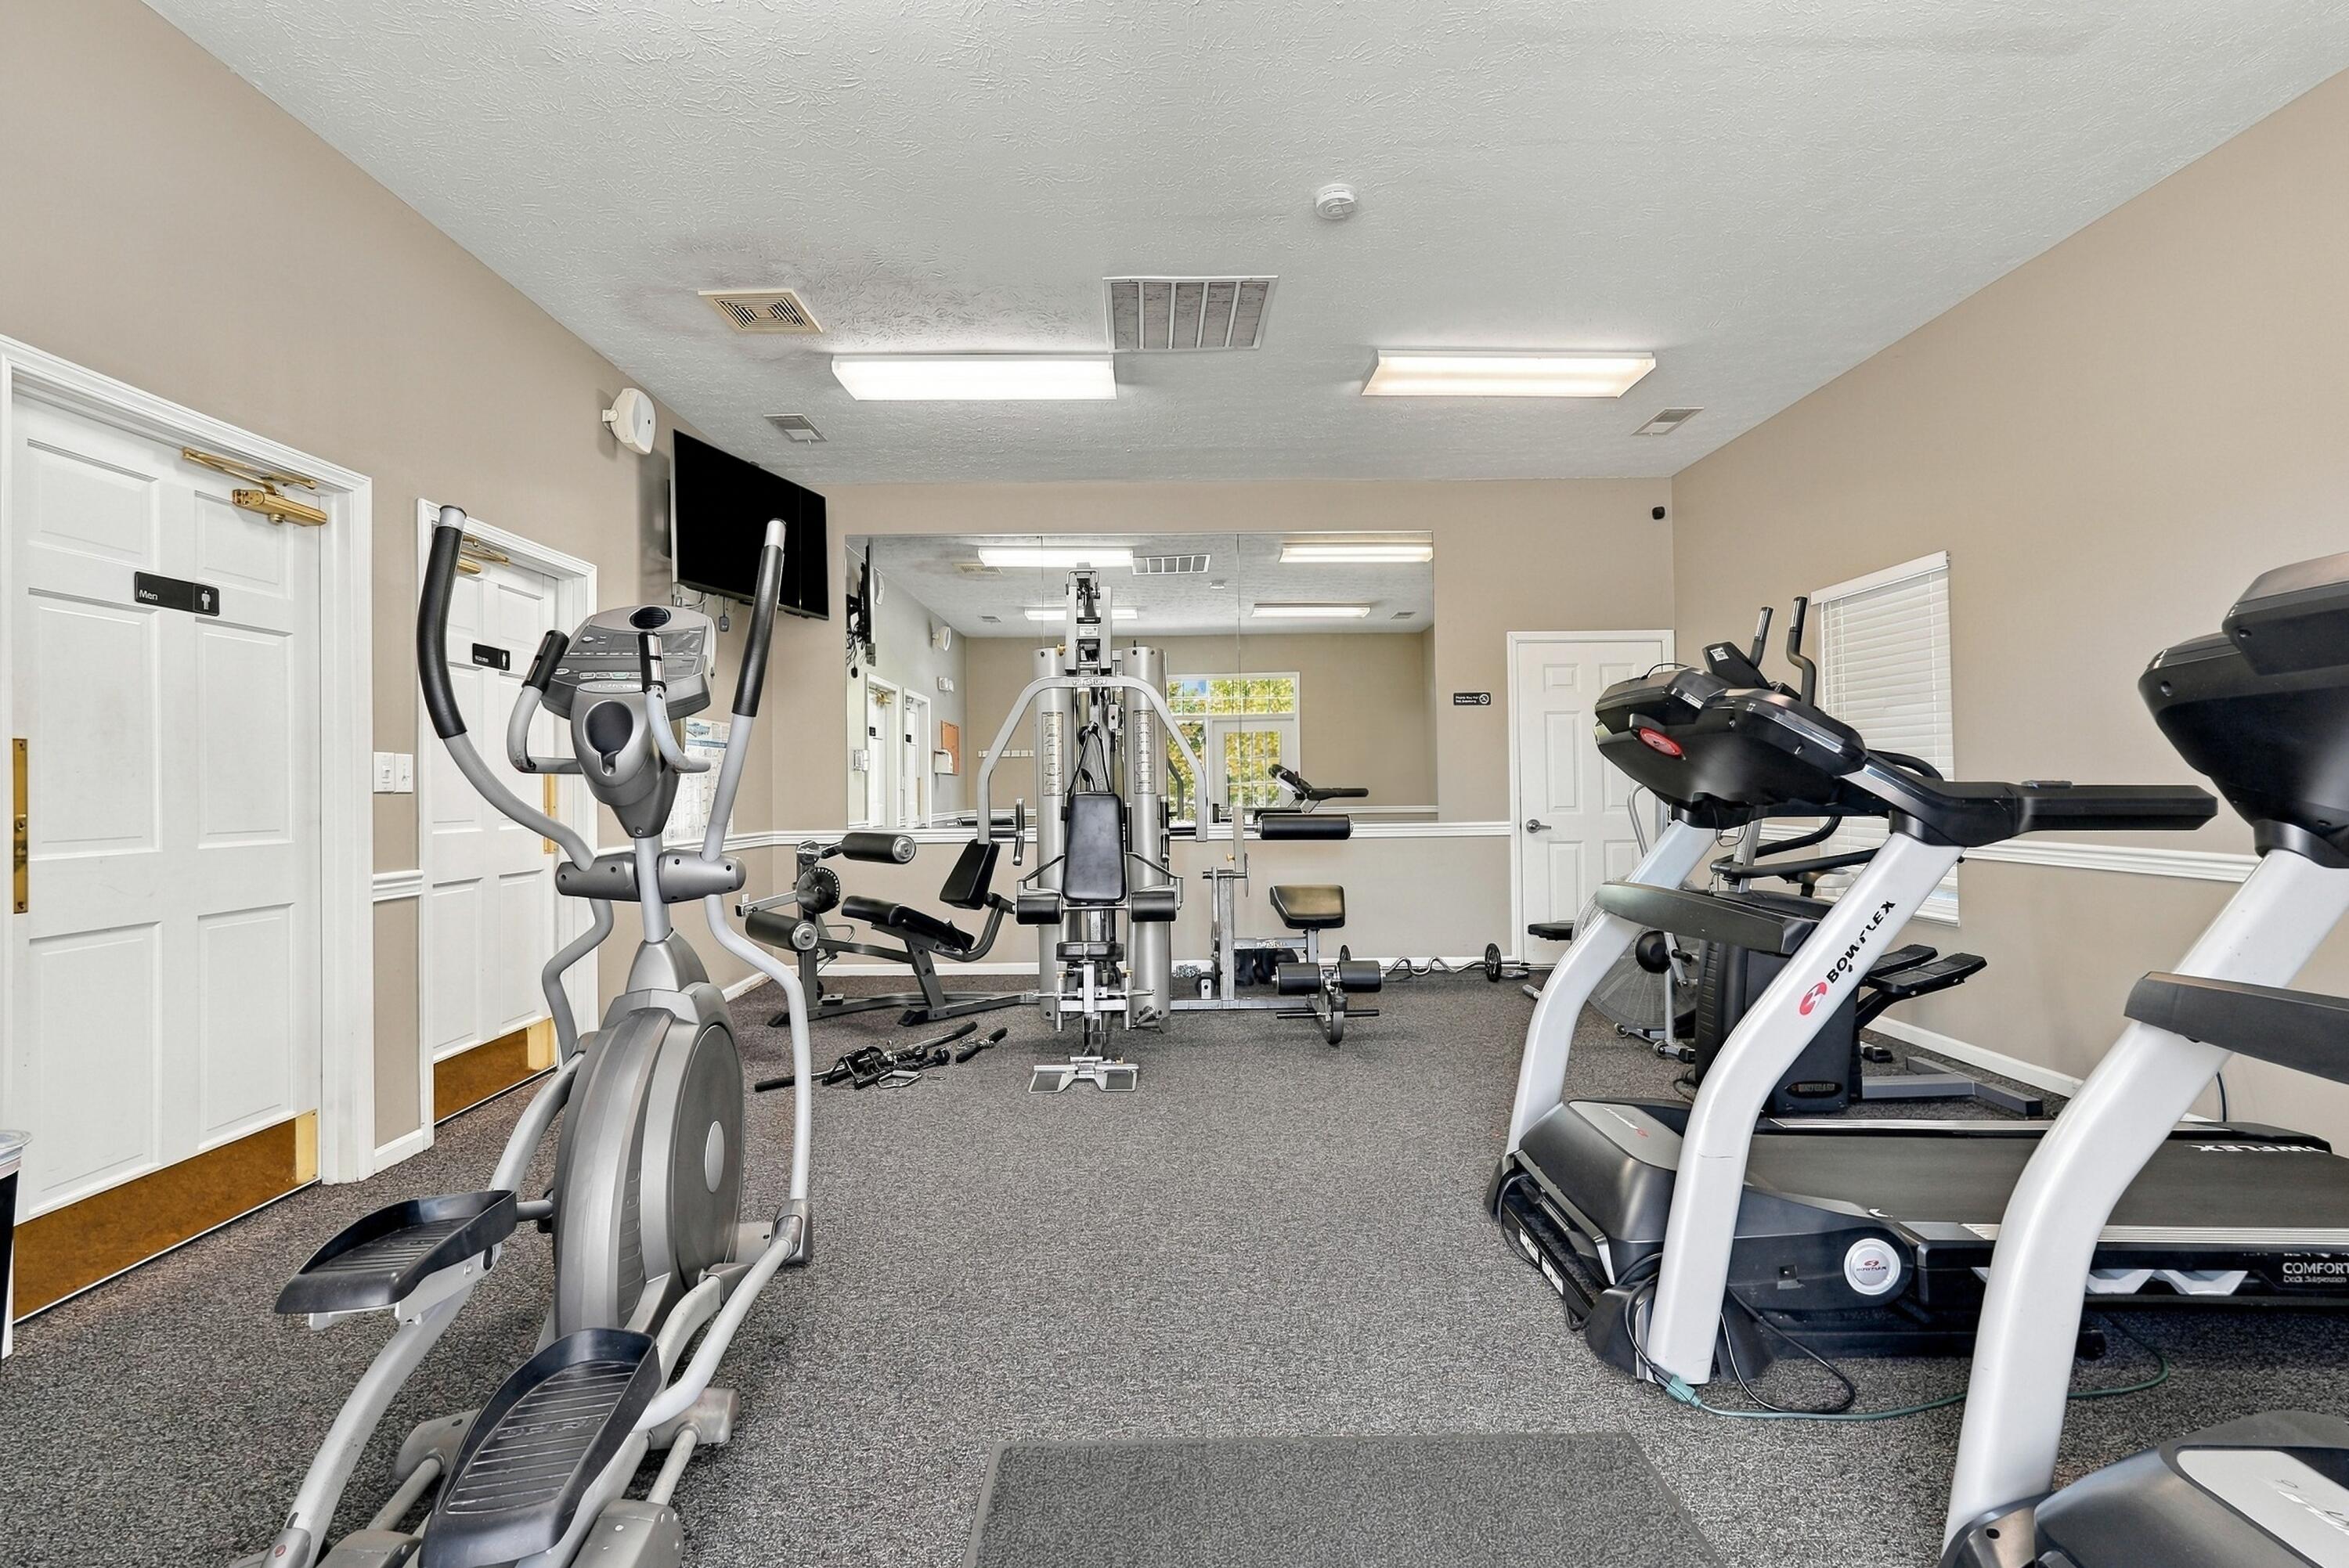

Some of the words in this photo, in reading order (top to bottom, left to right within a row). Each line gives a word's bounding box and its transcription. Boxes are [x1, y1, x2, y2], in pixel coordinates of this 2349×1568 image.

[139, 589, 158, 600] Men
[1826, 900, 1896, 984] BOWFLEX
[2282, 1262, 2349, 1274] COMFORT
